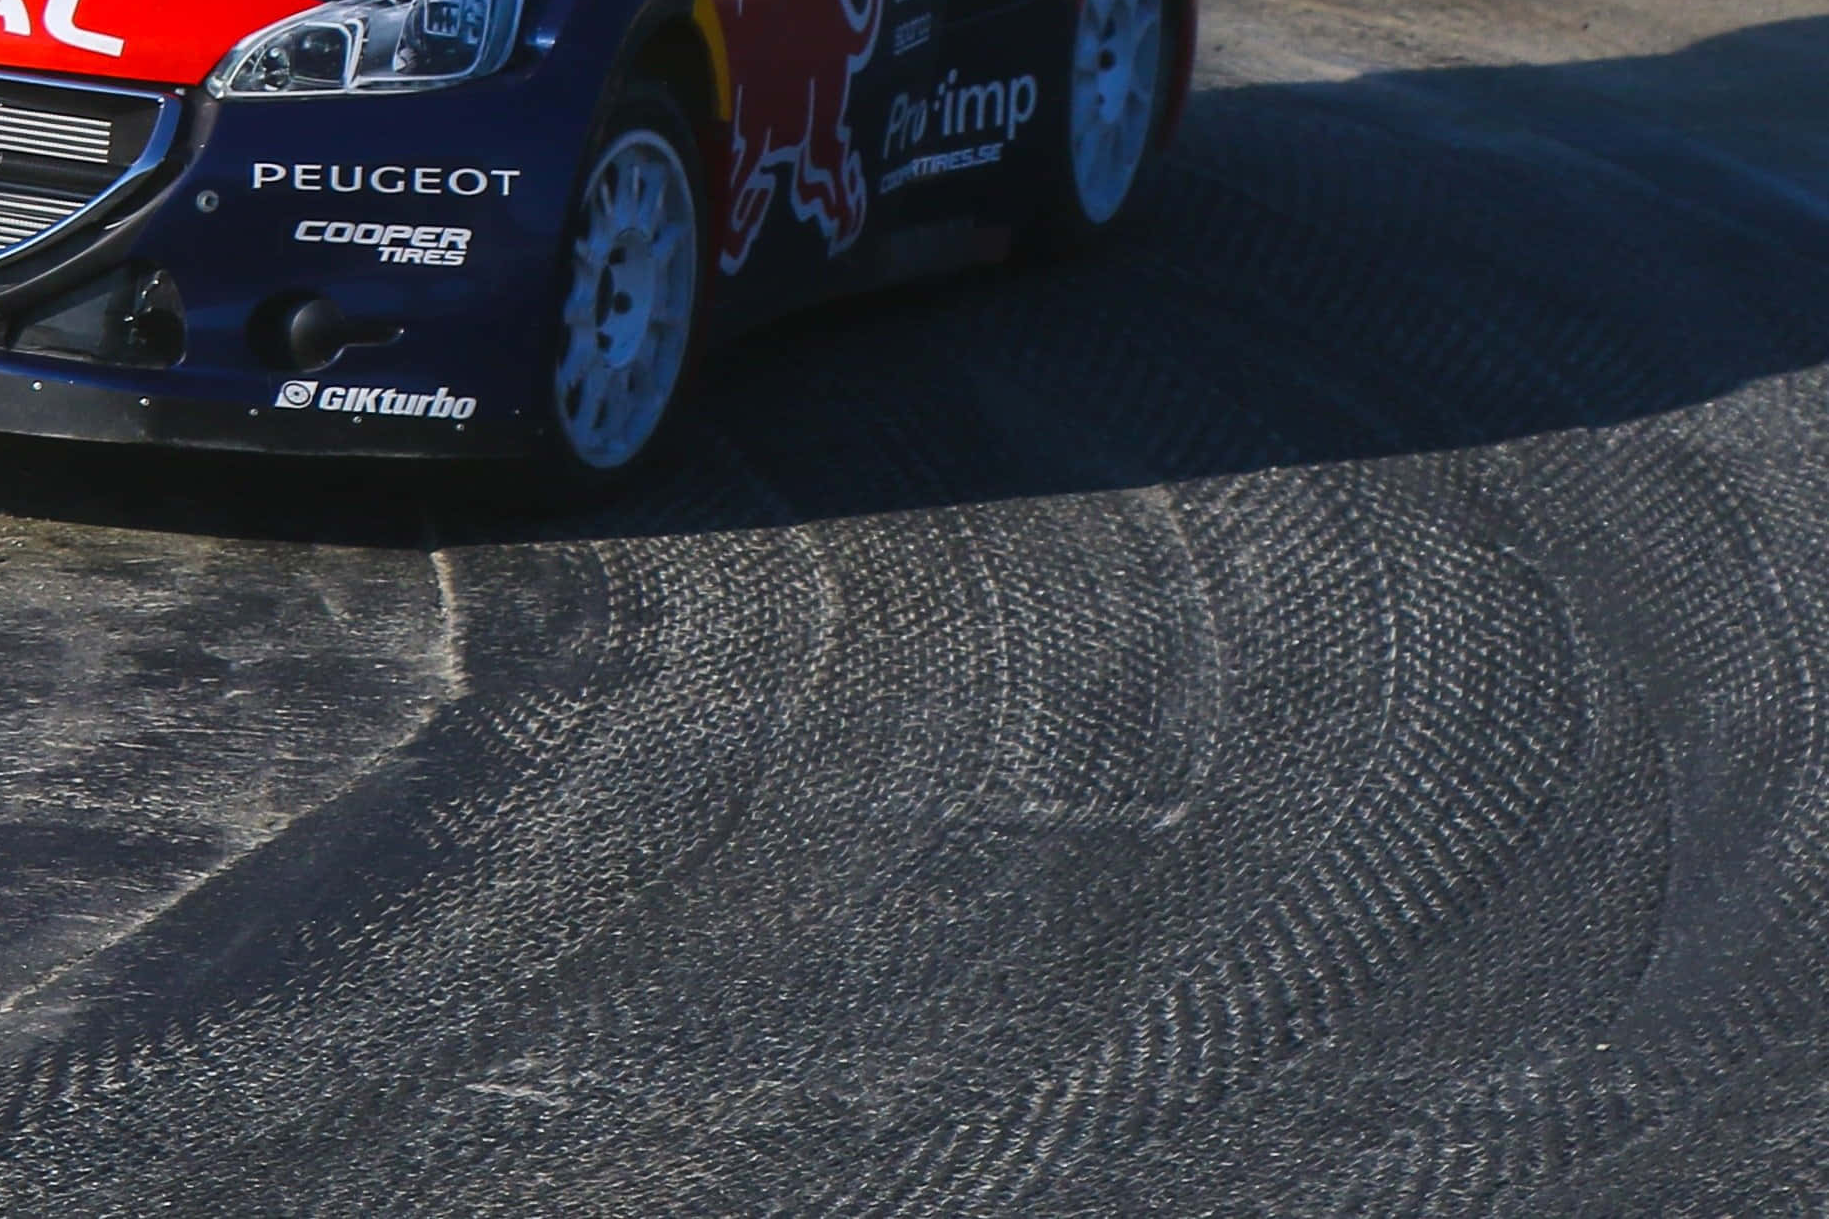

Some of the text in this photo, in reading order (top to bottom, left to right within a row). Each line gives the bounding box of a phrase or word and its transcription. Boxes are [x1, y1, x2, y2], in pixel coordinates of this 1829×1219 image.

[253, 163, 521, 196] PEUGEOT
[294, 220, 472, 249] COOPER
[378, 246, 467, 266] TIRES
